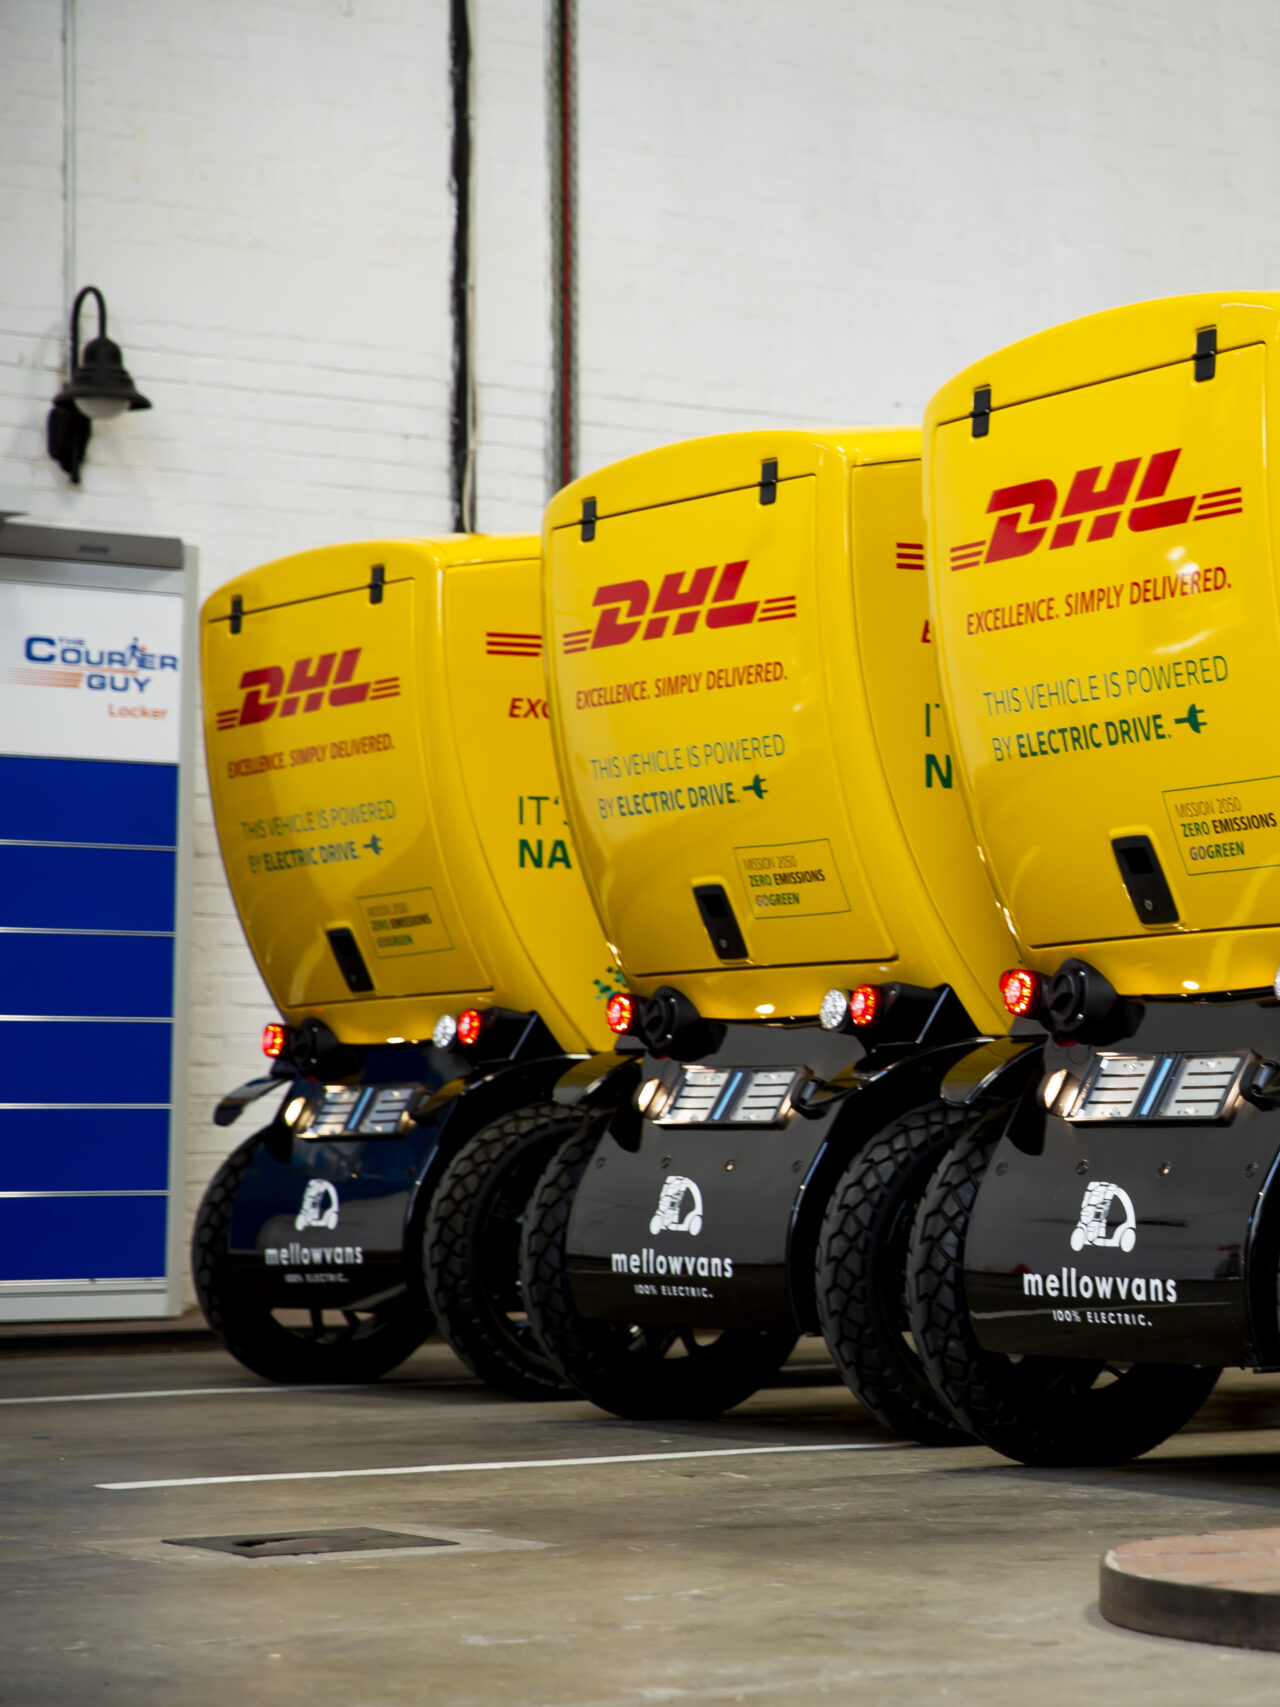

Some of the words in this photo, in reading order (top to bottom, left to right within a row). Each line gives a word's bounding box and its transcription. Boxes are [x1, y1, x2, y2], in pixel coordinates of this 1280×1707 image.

[983, 447, 1198, 565] DHL
[590, 559, 761, 650] DHL
[966, 596, 1060, 636] EXCELLENCE.
[1065, 583, 1124, 618] SIMPLY
[1129, 565, 1232, 606] DELIVERED.
[86, 673, 152, 693] GUY
[238, 646, 371, 727] DHL
[575, 680, 651, 710] EXCELLENCE.
[654, 671, 703, 698] SIMPLY
[705, 660, 788, 691] DELIVERED.
[983, 687, 1022, 717] THIS
[1023, 675, 1100, 711] VEHICLE
[1103, 671, 1122, 699] IS
[1125, 655, 1228, 695] POWERED
[107, 702, 168, 719] Locker
[992, 735, 1013, 762] BY
[1016, 723, 1103, 759] ELECTRIC
[1104, 714, 1172, 746] DRIVE.
[289, 743, 329, 768] SIMPLY
[590, 756, 622, 781] THIS
[622, 747, 683, 777] VEHICLE
[687, 744, 701, 768] IS
[703, 734, 786, 766] POWERED
[330, 799, 397, 828] POWERED
[518, 795, 569, 826] IT'
[597, 797, 615, 819] BY
[616, 788, 686, 817] ELECTRIC
[687, 781, 741, 809] DRIVE.
[1174, 800, 1215, 819] MISSION
[1215, 796, 1242, 814] 2050
[1180, 820, 1210, 838] ZERO
[1211, 812, 1277, 835] EMISSIONS
[1190, 841, 1245, 861] GOGREEN
[748, 873, 773, 888] ZERO
[772, 868, 826, 886] EMISSIONS
[755, 892, 800, 907] GOGREEN
[264, 1242, 363, 1266] mellowvans
[611, 1247, 733, 1278] mellowvans
[660, 1285, 714, 1298] ELECTRIC.
[1023, 1266, 1178, 1303] mellowvans
[1052, 1309, 1082, 1323] 100%
[1086, 1311, 1153, 1327] ELECTRIC.
